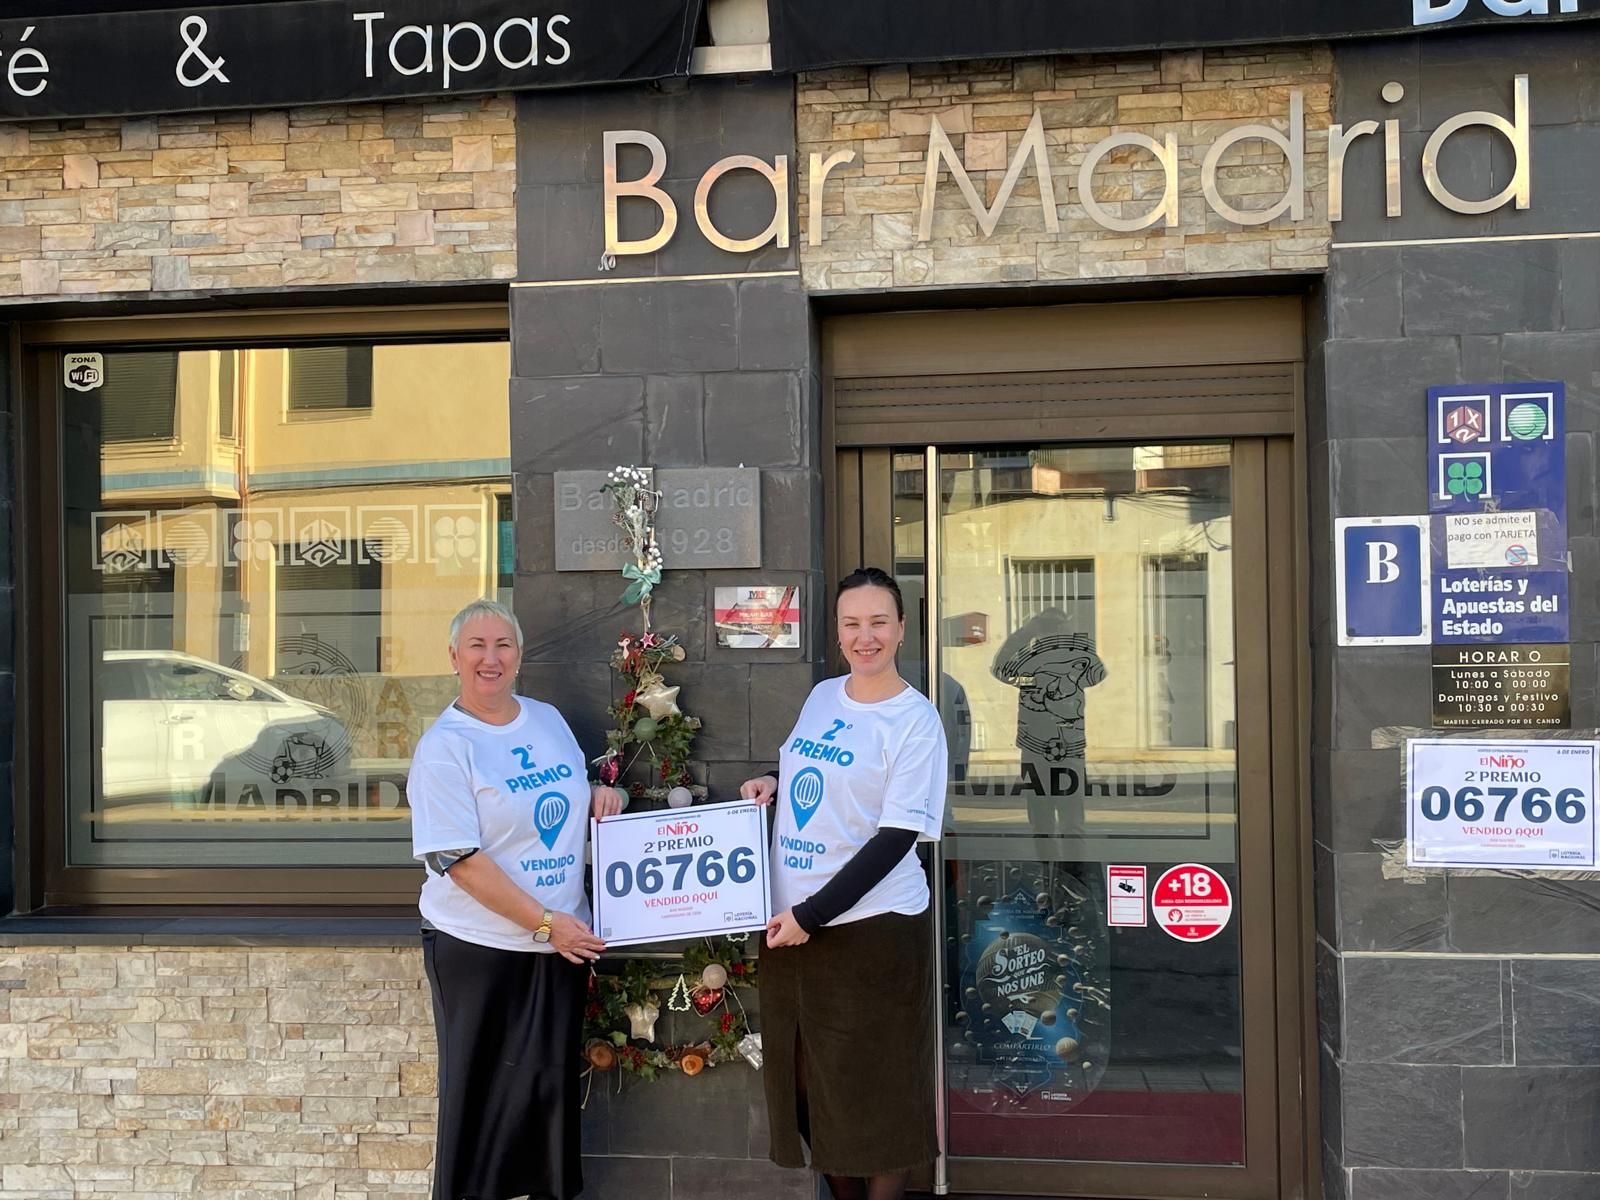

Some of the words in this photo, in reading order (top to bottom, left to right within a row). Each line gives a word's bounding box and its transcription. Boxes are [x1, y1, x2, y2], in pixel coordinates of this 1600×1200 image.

[0, 26, 49, 97] é
[175, 16, 230, 88] &
[352, 11, 572, 89] Tapas
[602, 129, 856, 256] Bar
[916, 73, 1531, 242] Madrid
[661, 479, 753, 509] adrid
[1454, 517, 1470, 526] NO
[1485, 515, 1520, 525] admite
[1522, 514, 1532, 523] el
[1447, 533, 1472, 543] pago
[1474, 532, 1492, 540] con
[1494, 529, 1536, 539] TARJETA
[1364, 541, 1400, 585] B
[1441, 576, 1513, 593] Loterías
[1518, 578, 1529, 595] y
[1442, 597, 1525, 618] Apuestas
[1530, 594, 1559, 612] del
[1442, 618, 1504, 636] Estado
[1451, 670, 1485, 679] Lunes
[1456, 680, 1489, 689] 10:00
[1512, 680, 1547, 688] 00:00
[1438, 693, 1499, 703] Domingos
[1515, 693, 1559, 701] Festivo
[1458, 704, 1492, 713] 10:30
[1510, 703, 1545, 712] 00:30
[790, 738, 855, 767] PREMIO
[1490, 755, 1526, 769] Niño
[505, 763, 573, 794] PREMIO
[954, 762, 1178, 797] MADRID
[1480, 770, 1542, 783] PREMIO
[1420, 785, 1586, 824] 06766
[666, 821, 699, 836] Niño
[1462, 826, 1512, 836] VENDIDO
[658, 834, 714, 852] PREMIO
[520, 854, 575, 872] VENDIDO
[605, 846, 756, 898] 06766
[535, 869, 566, 888] AQUÍ
[1168, 872, 1212, 897] +18
[644, 894, 690, 908] VENDIDO
[1014, 944, 1030, 956] EL
[997, 980, 1019, 997] NOS
[1020, 972, 1045, 990] UNE
